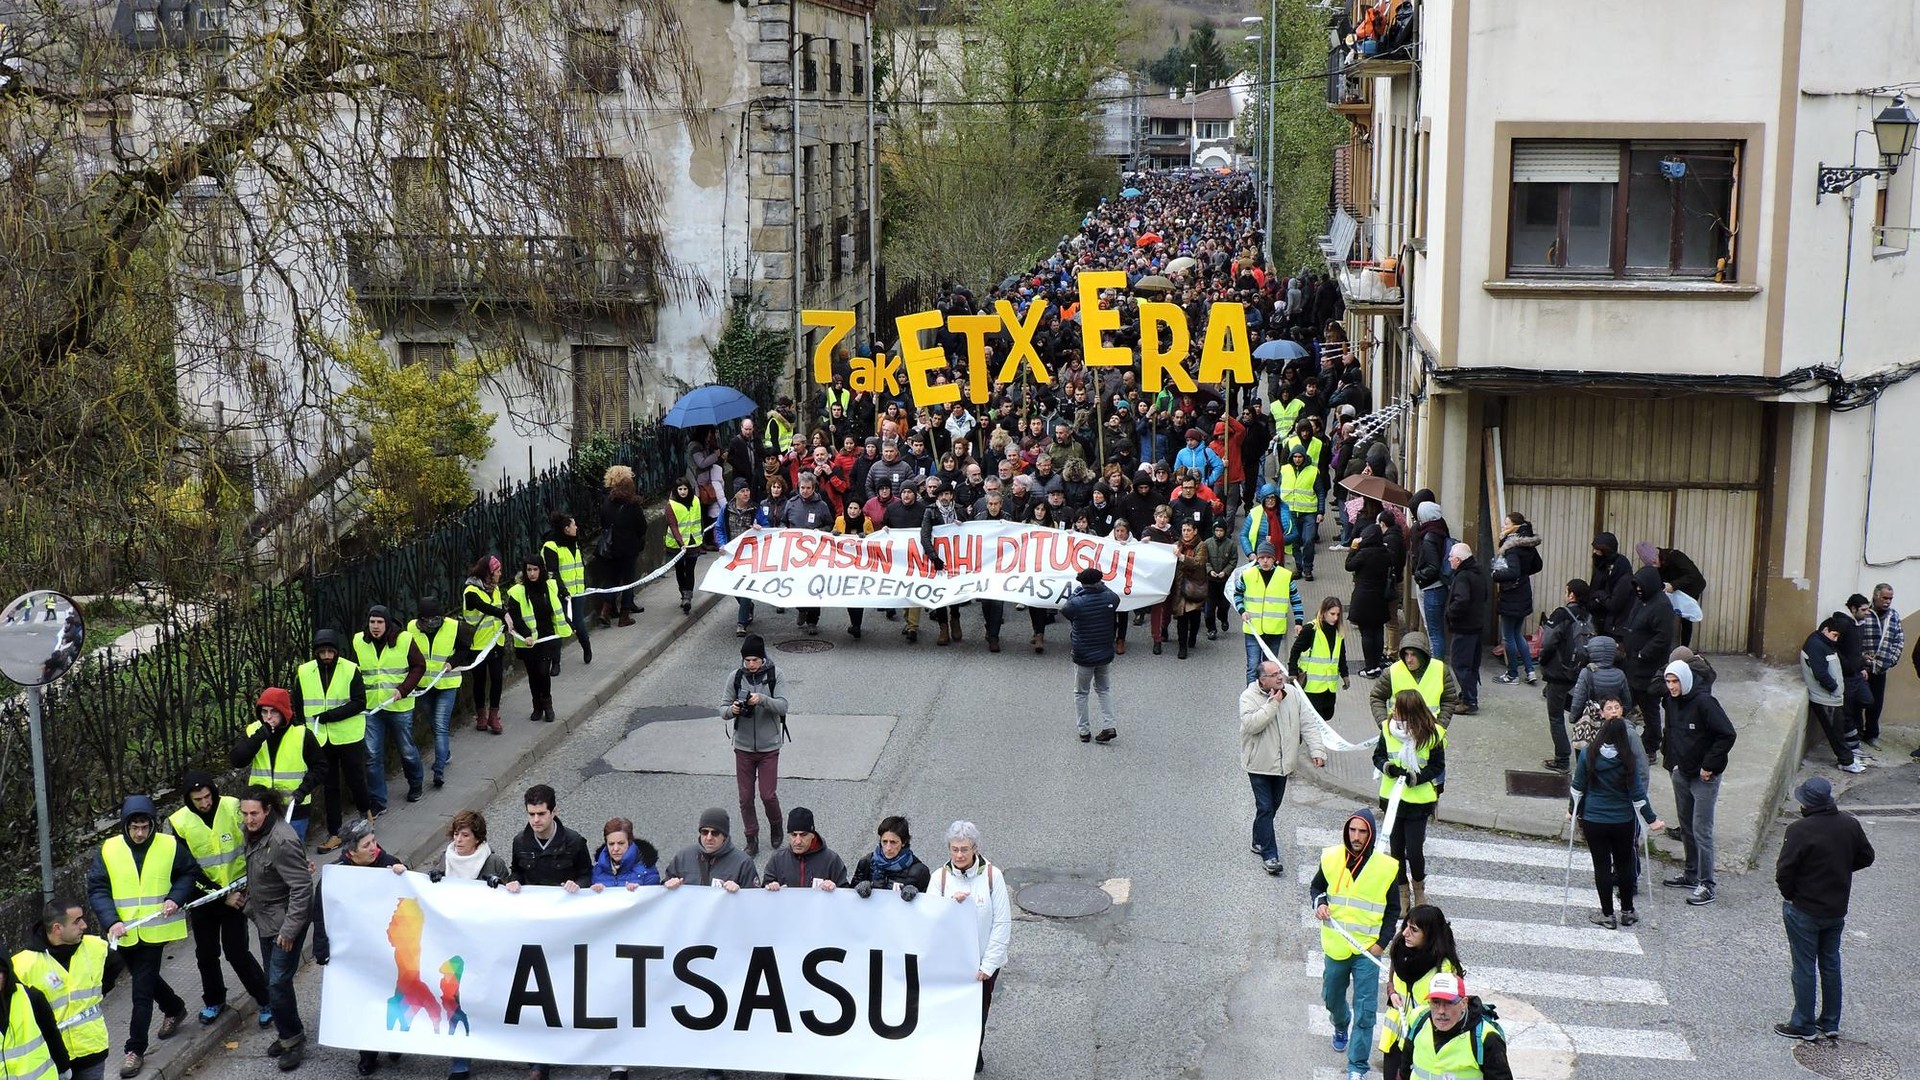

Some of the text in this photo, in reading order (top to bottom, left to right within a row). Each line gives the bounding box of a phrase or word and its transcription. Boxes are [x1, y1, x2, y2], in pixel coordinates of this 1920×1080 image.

[725, 531, 893, 574] ALTSASUN
[995, 531, 1136, 595] DITUGU!
[808, 574, 946, 603] QUEREMOS
[954, 578, 989, 595] EN
[504, 943, 920, 1041] ALTSASU
